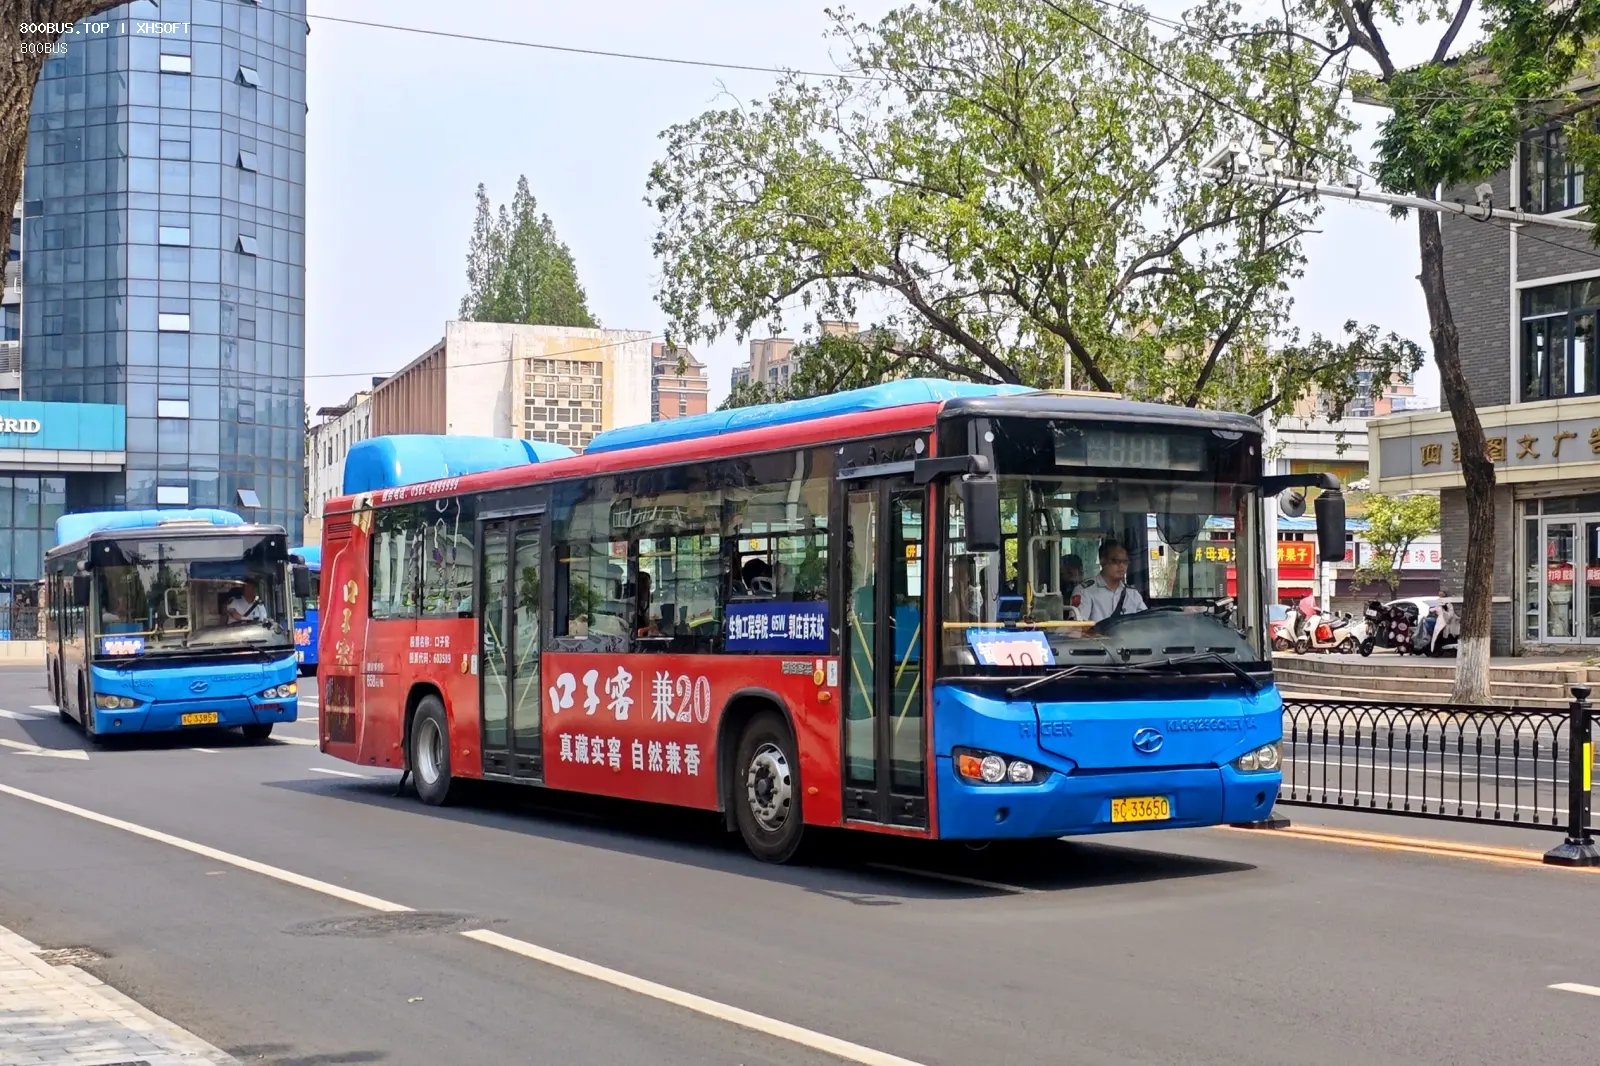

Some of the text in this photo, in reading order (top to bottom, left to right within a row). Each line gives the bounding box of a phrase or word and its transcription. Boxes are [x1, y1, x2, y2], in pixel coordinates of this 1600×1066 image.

[728, 614, 769, 640] 生物工程学院
[548, 665, 711, 724] 口子窖 兼20
[631, 738, 702, 776] 自然兼香
